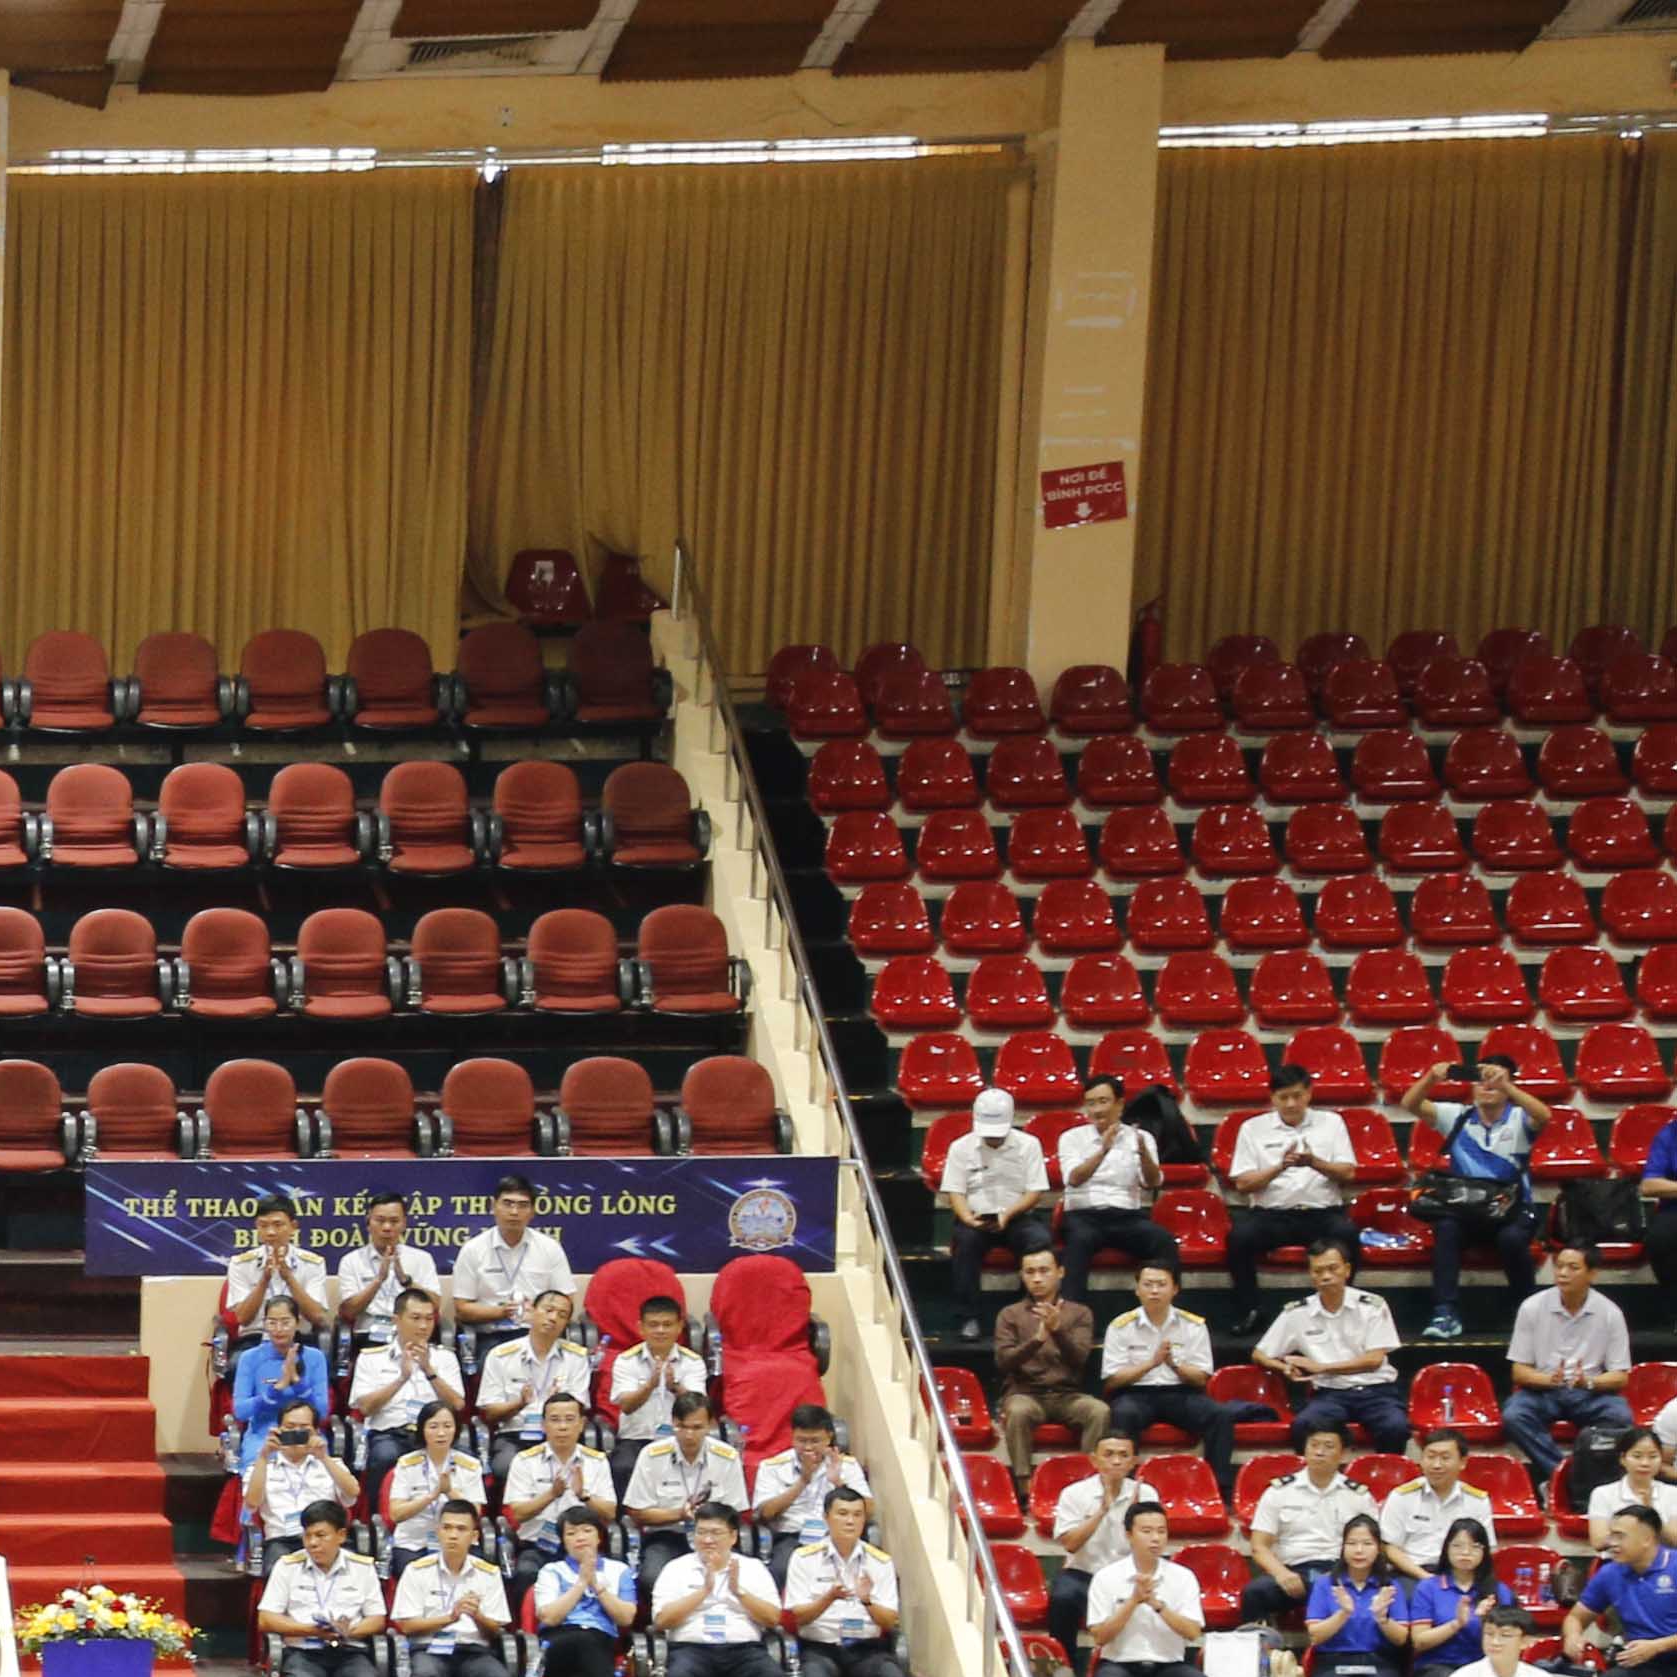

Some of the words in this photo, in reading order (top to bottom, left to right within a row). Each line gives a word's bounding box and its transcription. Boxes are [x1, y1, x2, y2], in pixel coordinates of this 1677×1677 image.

[1084, 481, 1123, 497] PCCC
[123, 1189, 178, 1217] THỂ
[186, 1198, 258, 1217] THAO
[601, 1190, 677, 1215] LÒNG
[310, 1223, 372, 1248] ĐOÀ
